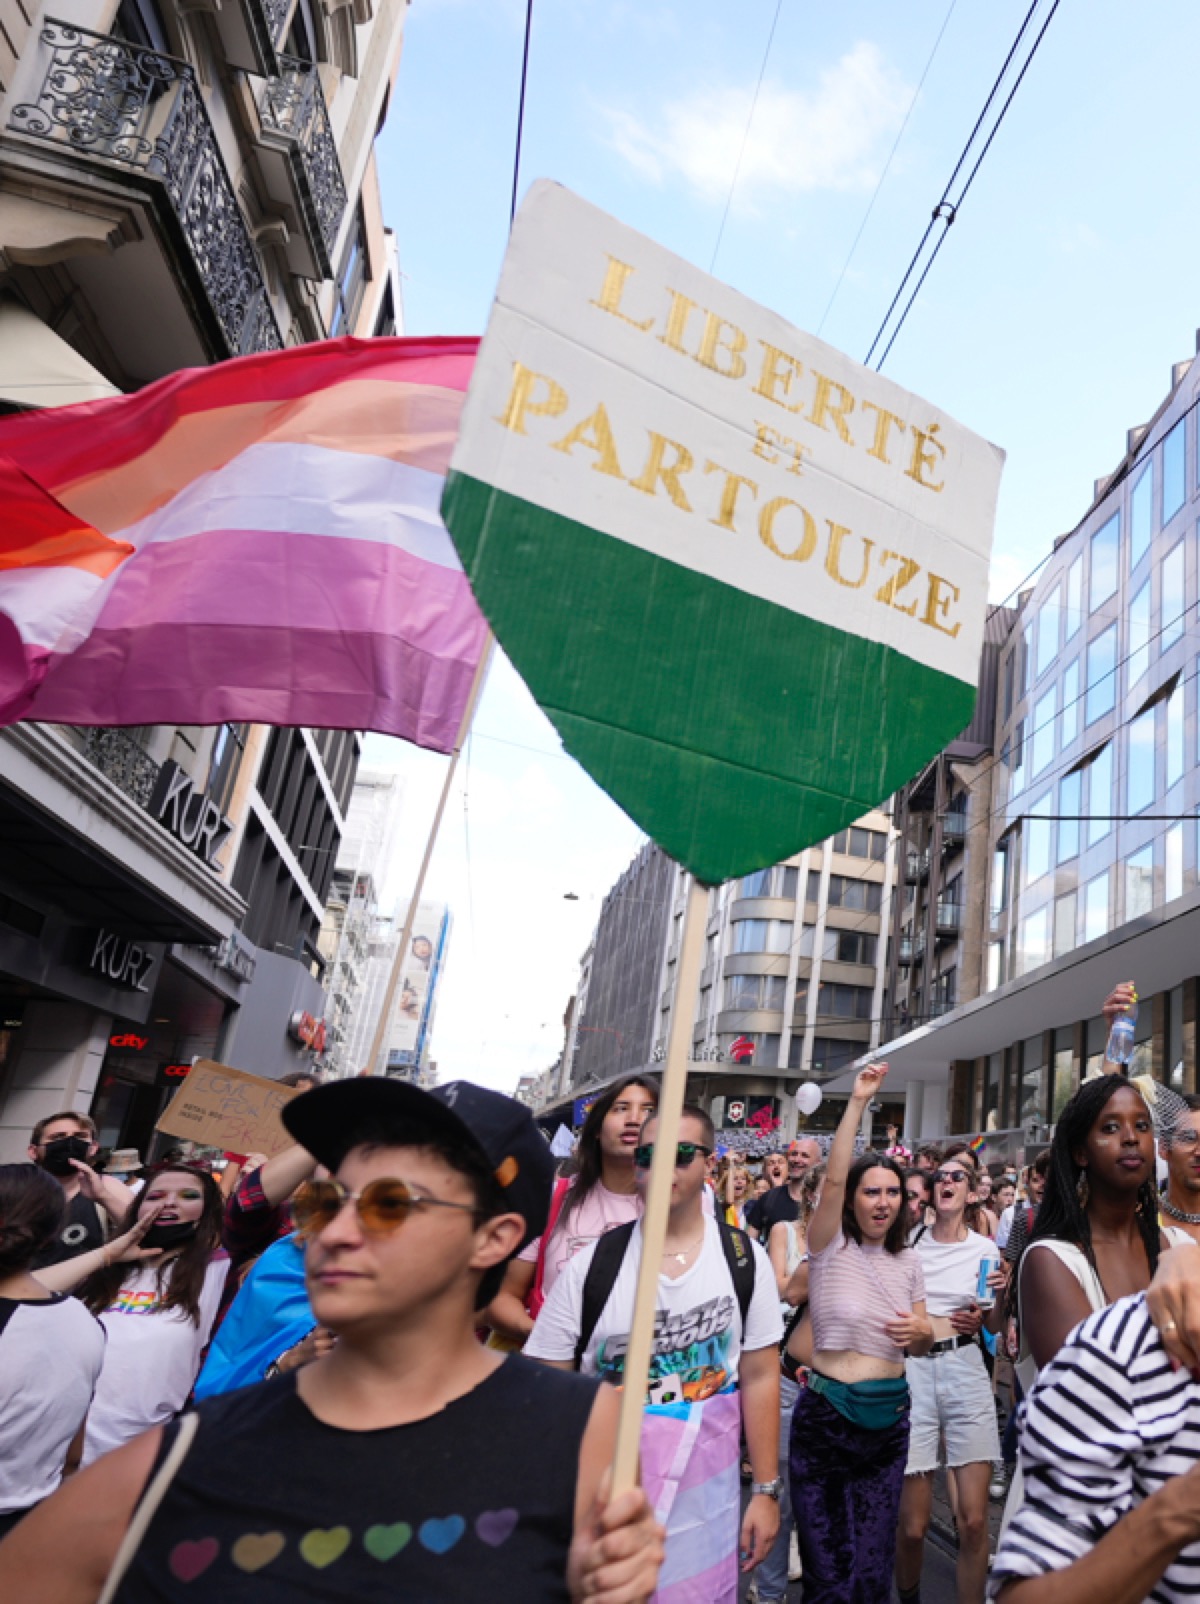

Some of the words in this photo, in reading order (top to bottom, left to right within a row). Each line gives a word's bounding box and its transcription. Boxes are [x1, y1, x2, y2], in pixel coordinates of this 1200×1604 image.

[588, 252, 947, 493] LIBERTÉ
[751, 418, 812, 477] ET
[491, 360, 963, 640] PARTOUZE
[159, 764, 236, 873] KURZ
[89, 928, 153, 993] KURZ
[110, 1034, 148, 1050] city
